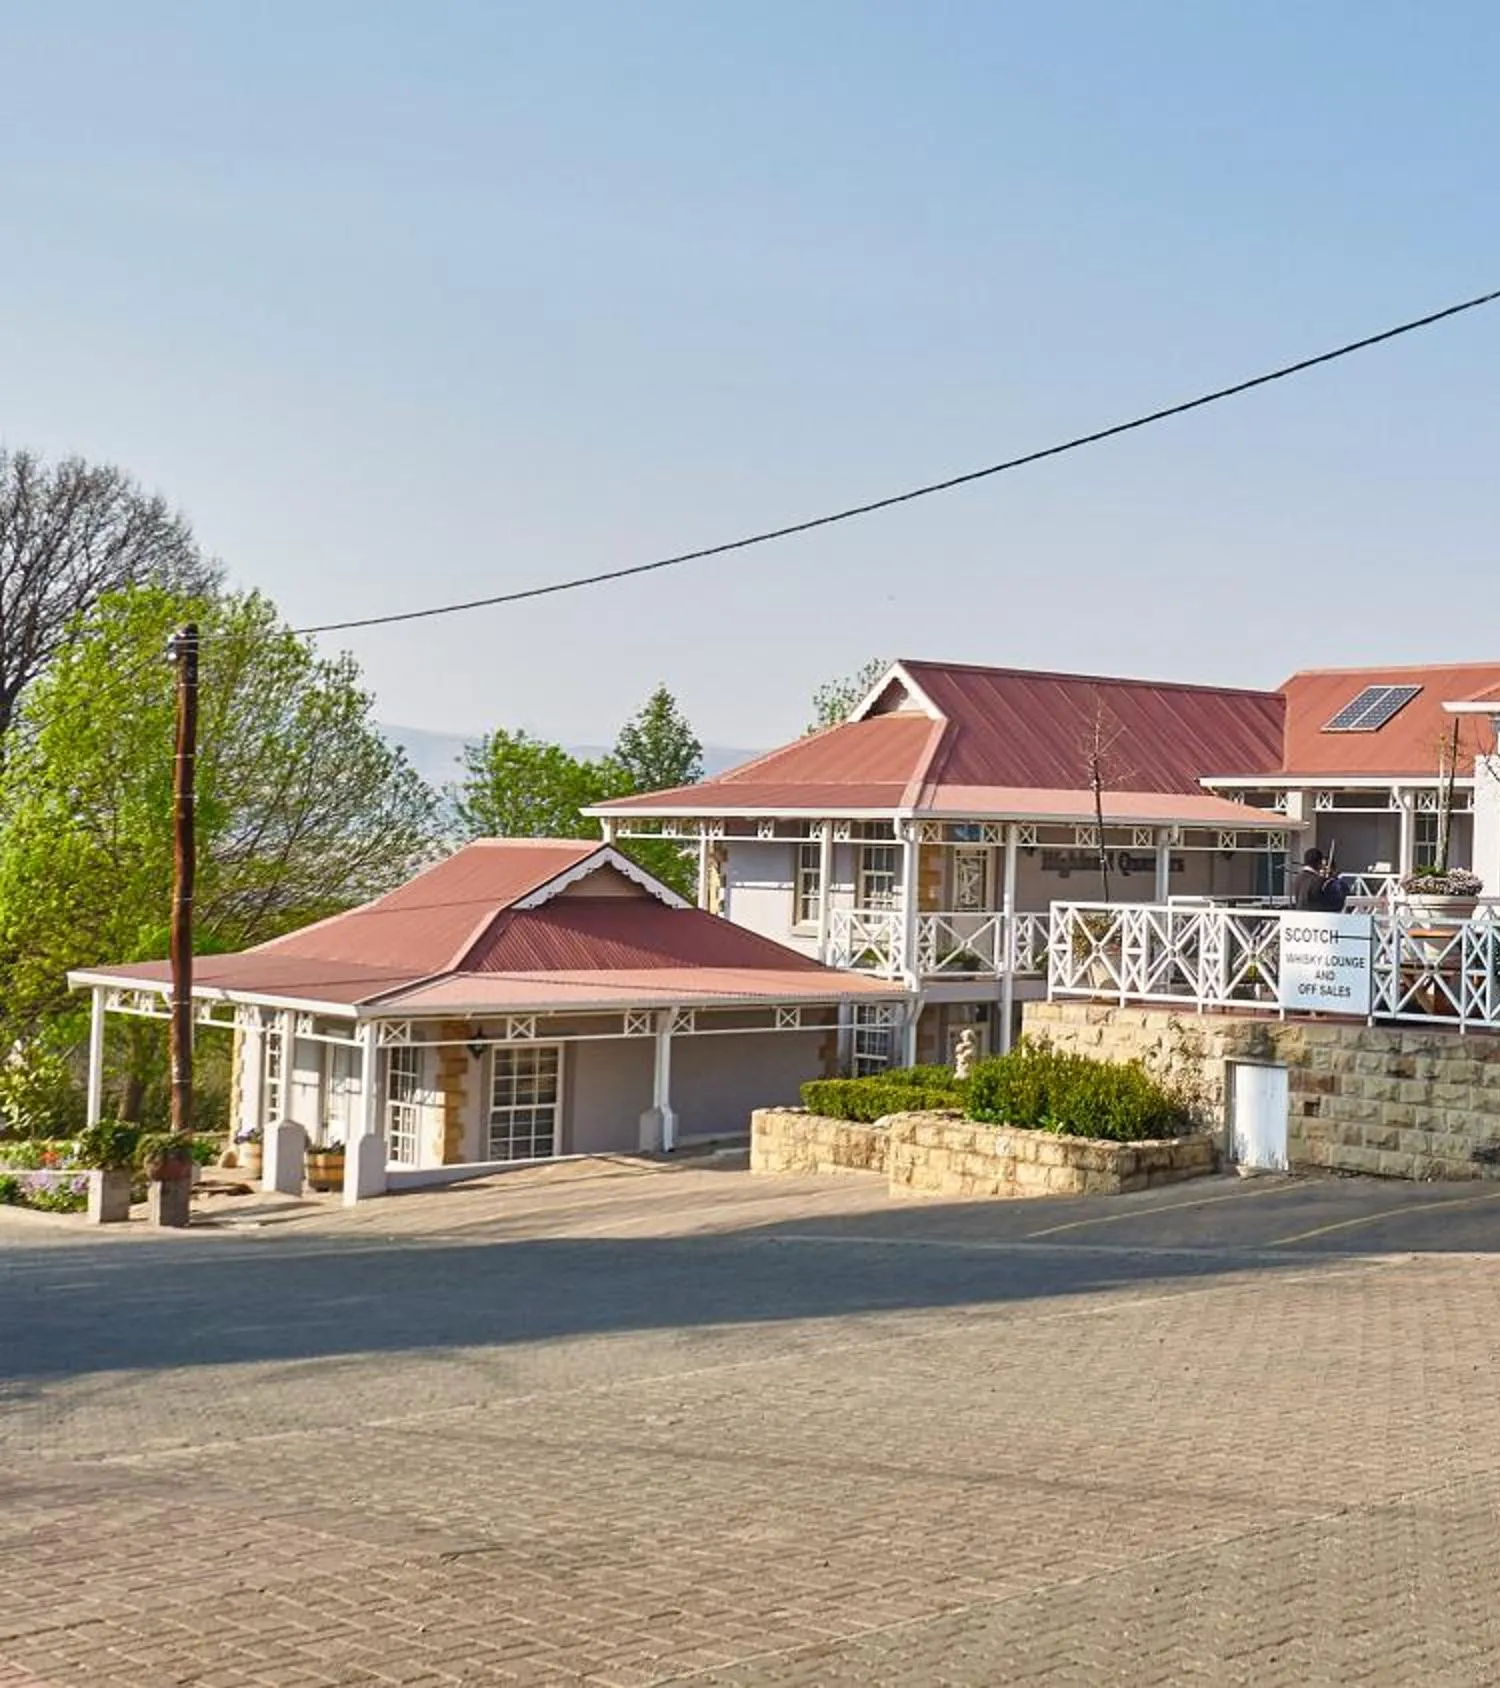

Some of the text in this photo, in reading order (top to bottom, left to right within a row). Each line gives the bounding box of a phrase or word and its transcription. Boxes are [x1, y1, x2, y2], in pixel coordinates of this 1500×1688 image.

[1284, 927, 1339, 944] SCOTCH
[1285, 952, 1365, 969] WHISKY LOUNGE
[1315, 969, 1335, 981] AND
[1298, 983, 1351, 998] OFF SALES
